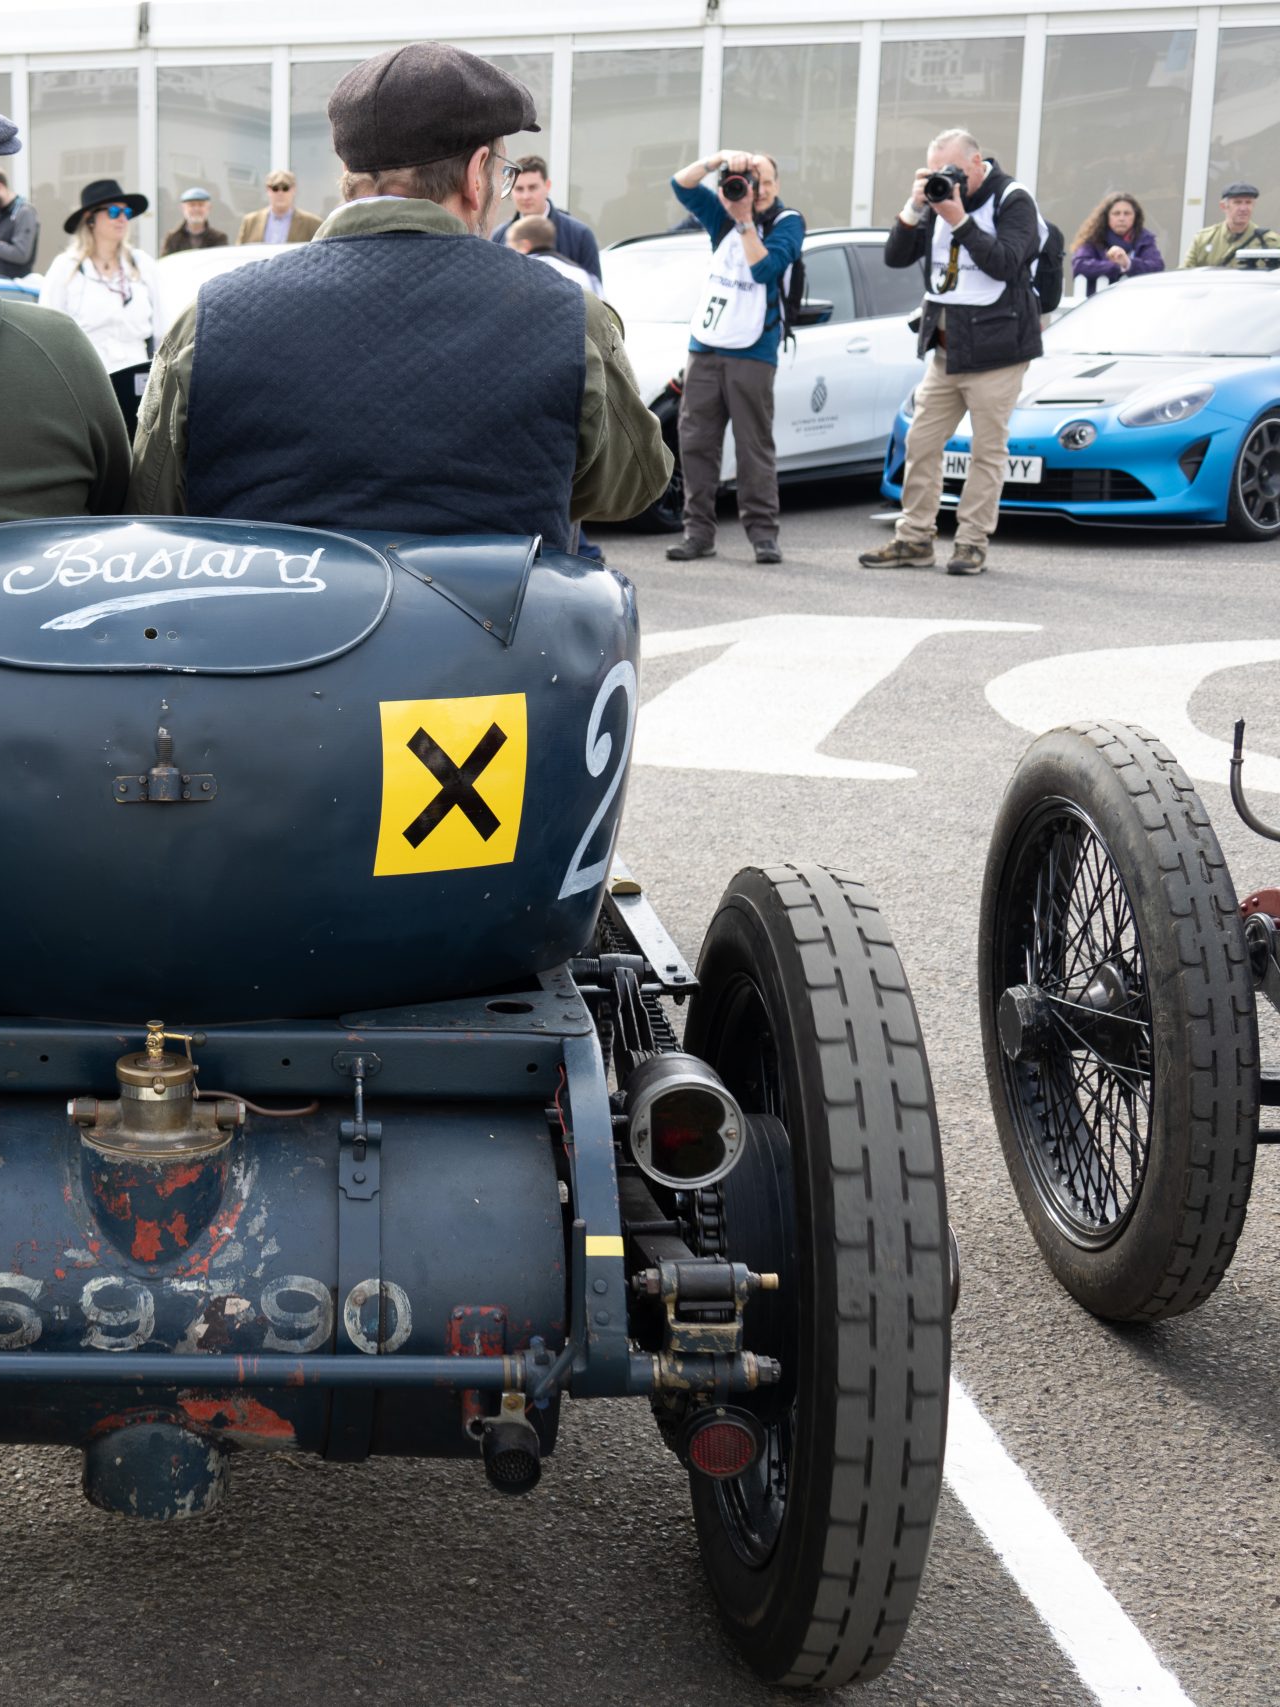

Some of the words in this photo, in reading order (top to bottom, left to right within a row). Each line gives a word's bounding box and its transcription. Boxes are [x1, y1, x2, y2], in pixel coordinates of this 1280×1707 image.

[702, 296, 728, 331] 57
[3, 539, 327, 595] Bastard
[557, 660, 636, 900] 2
